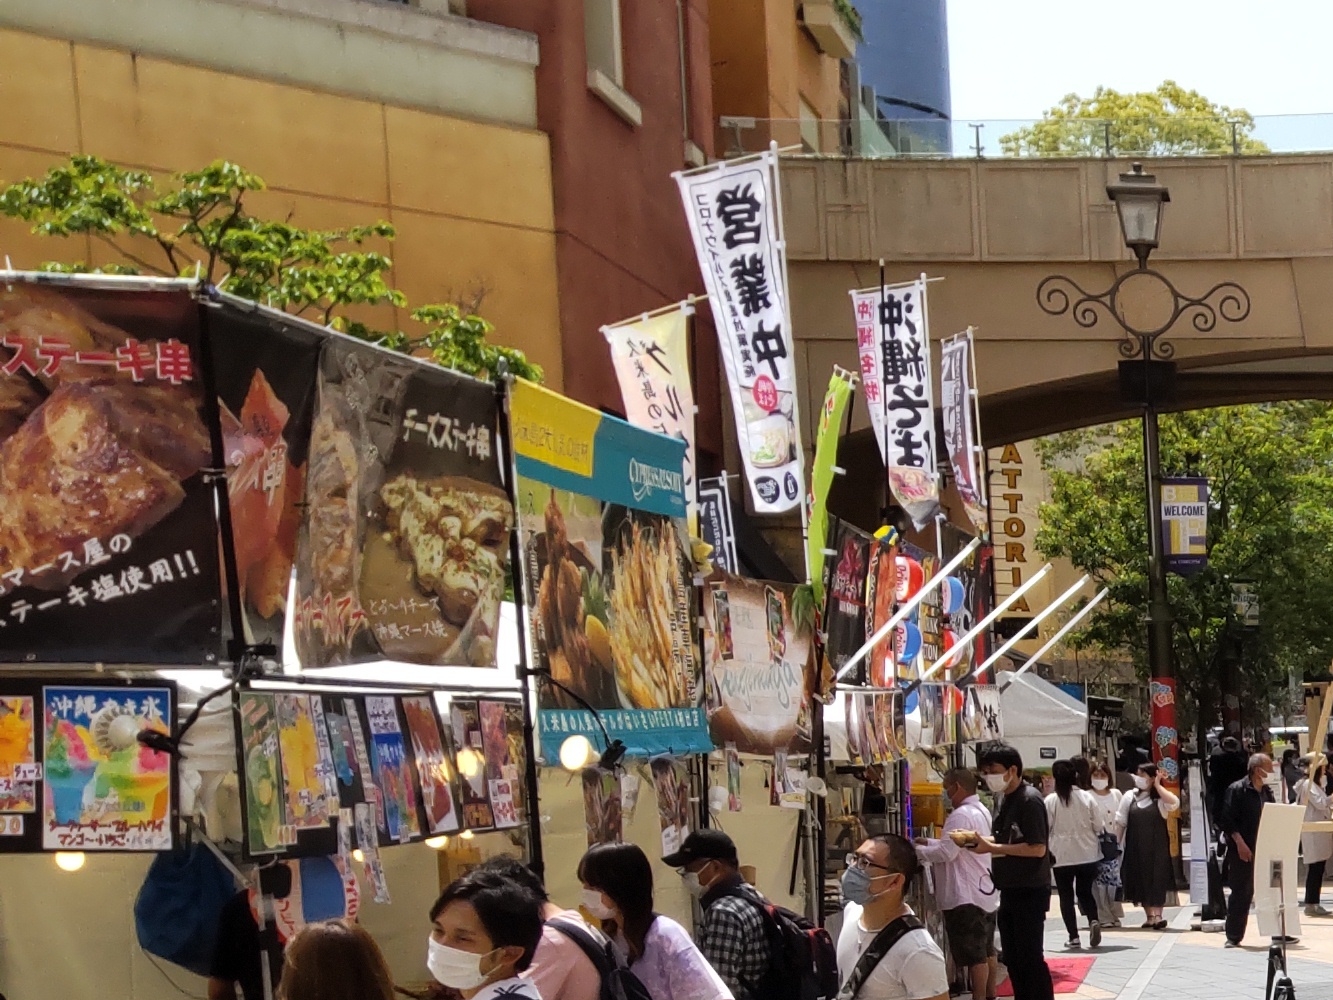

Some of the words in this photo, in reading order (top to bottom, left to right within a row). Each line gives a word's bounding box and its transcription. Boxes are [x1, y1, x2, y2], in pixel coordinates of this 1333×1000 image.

[1, 336, 194, 384] ステーキ串
[403, 407, 492, 462] チーズステーキ串
[1164, 504, 1205, 518] WELCOME
